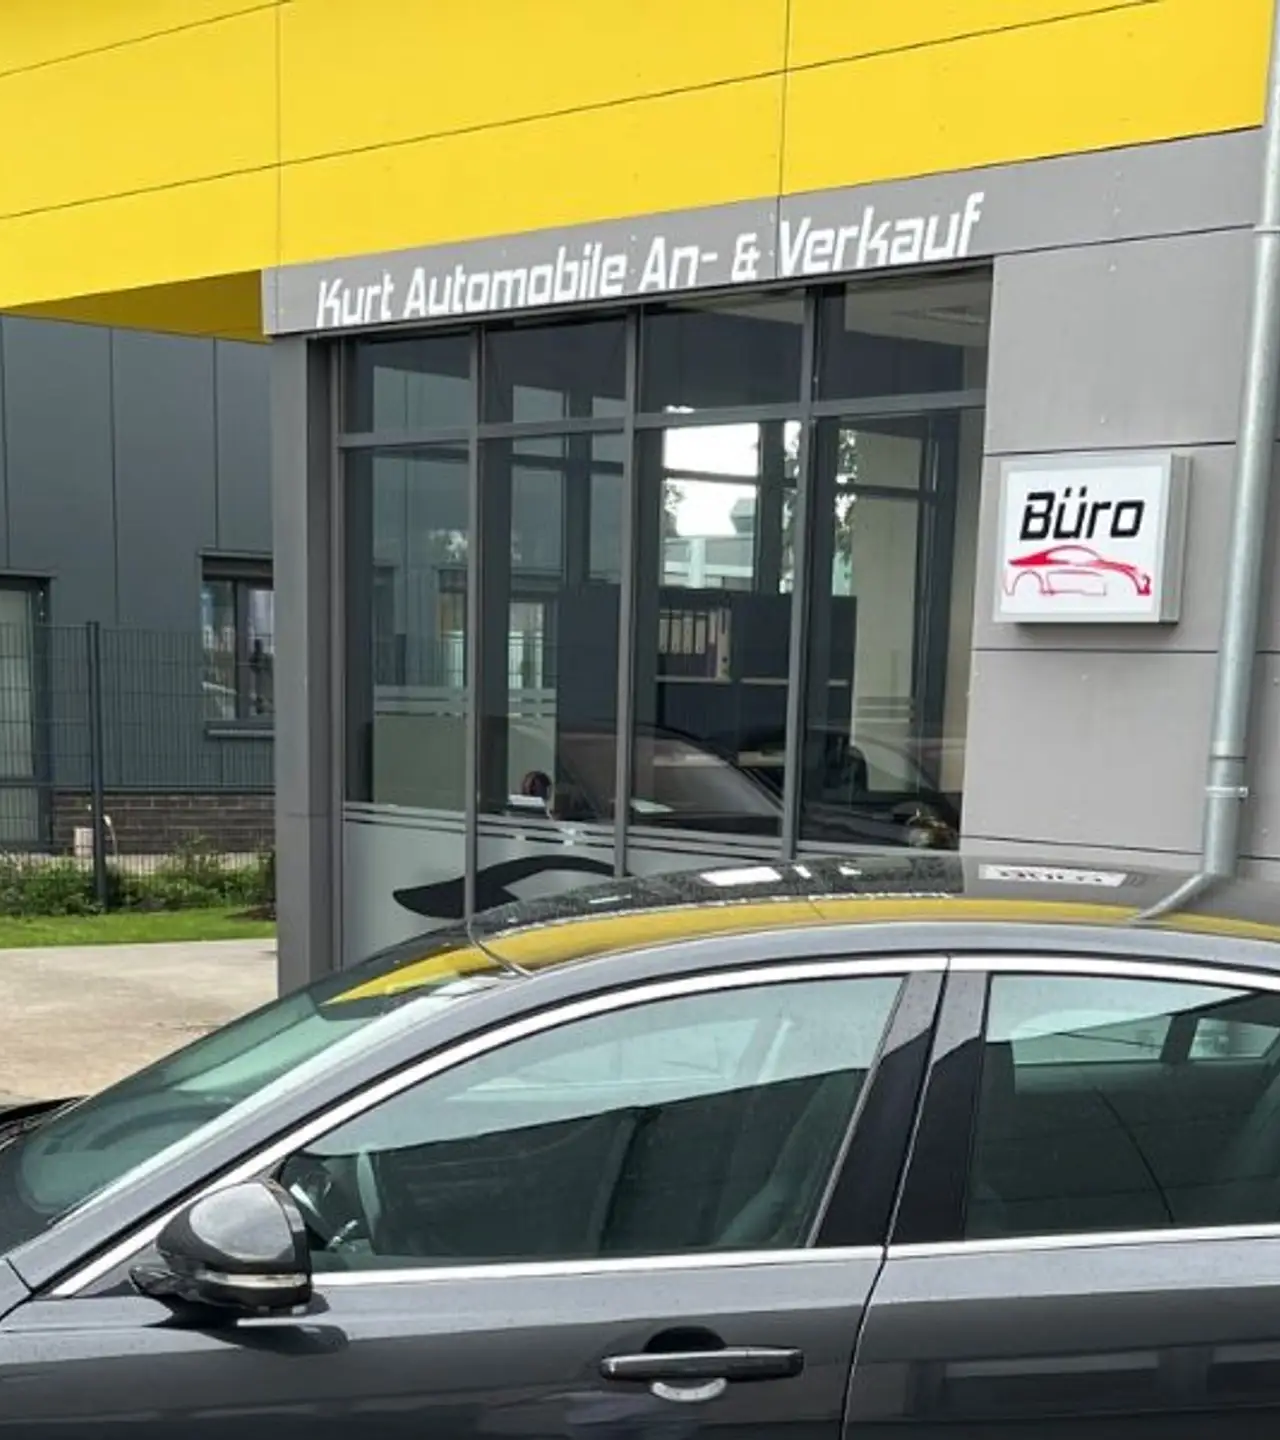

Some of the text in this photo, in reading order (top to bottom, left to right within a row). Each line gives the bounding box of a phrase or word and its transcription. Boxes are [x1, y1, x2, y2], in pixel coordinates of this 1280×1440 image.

[316, 191, 985, 328] Kurt Automobile An- & Verkauf
[1019, 486, 1146, 541] Büro
